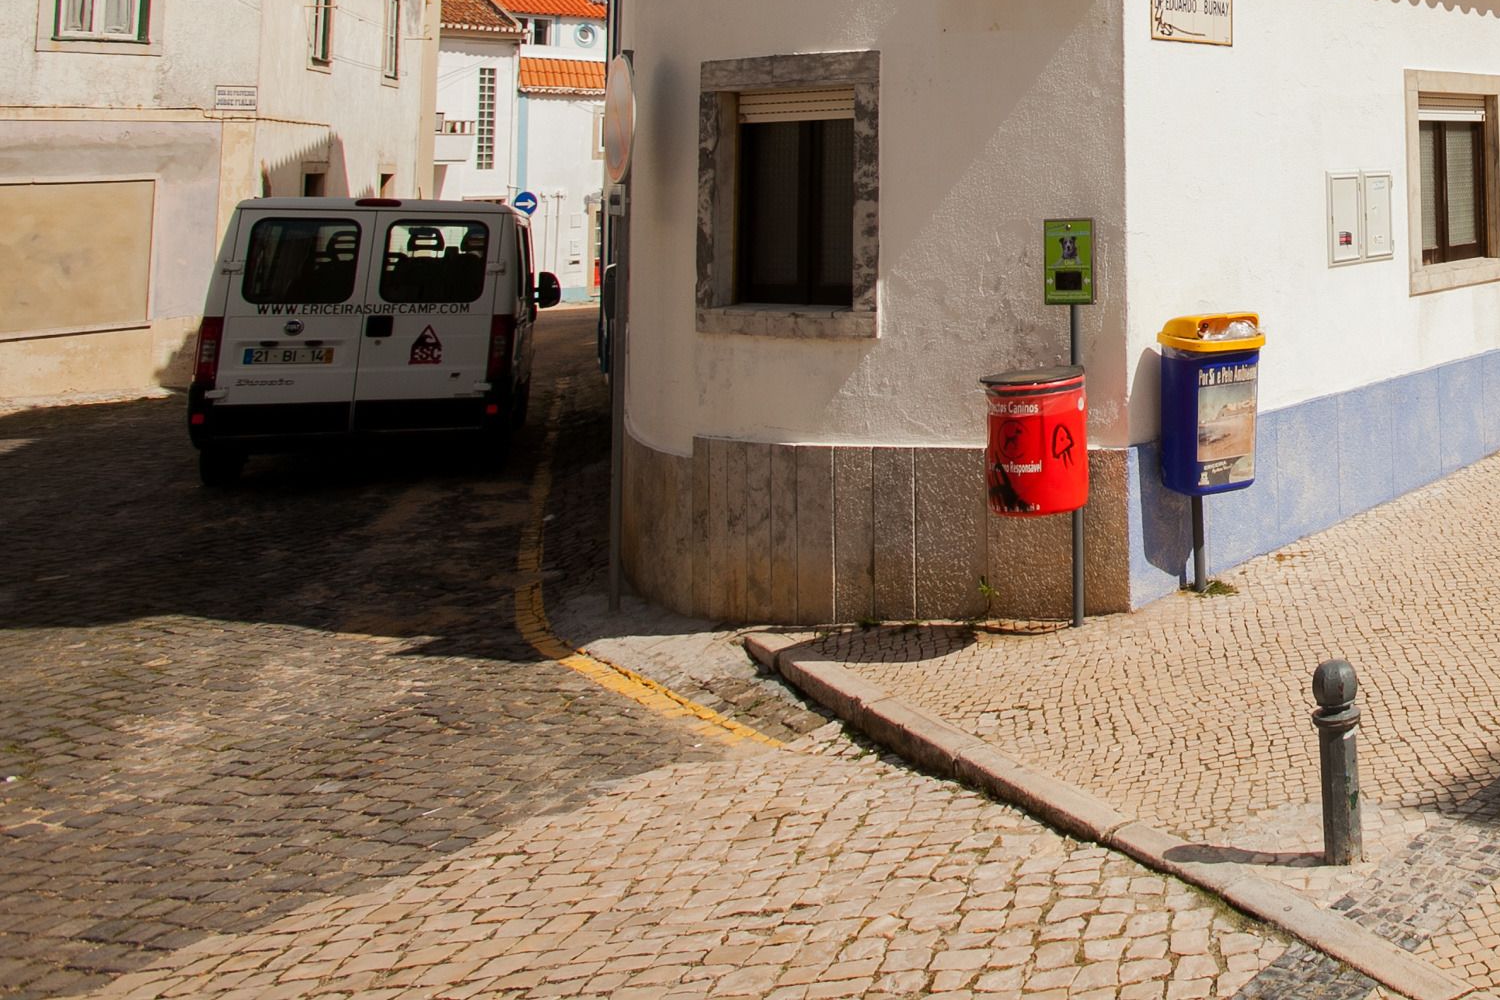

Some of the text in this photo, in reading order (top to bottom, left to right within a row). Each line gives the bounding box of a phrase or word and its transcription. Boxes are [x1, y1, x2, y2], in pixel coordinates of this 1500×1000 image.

[1203, 0, 1229, 17] BURNAY
[256, 302, 471, 316] WWW.ERICEIRASURFCAMP.COM
[1198, 368, 1209, 387] Por
[1008, 400, 1039, 414] Caninos
[1009, 459, 1043, 477] Responsável
